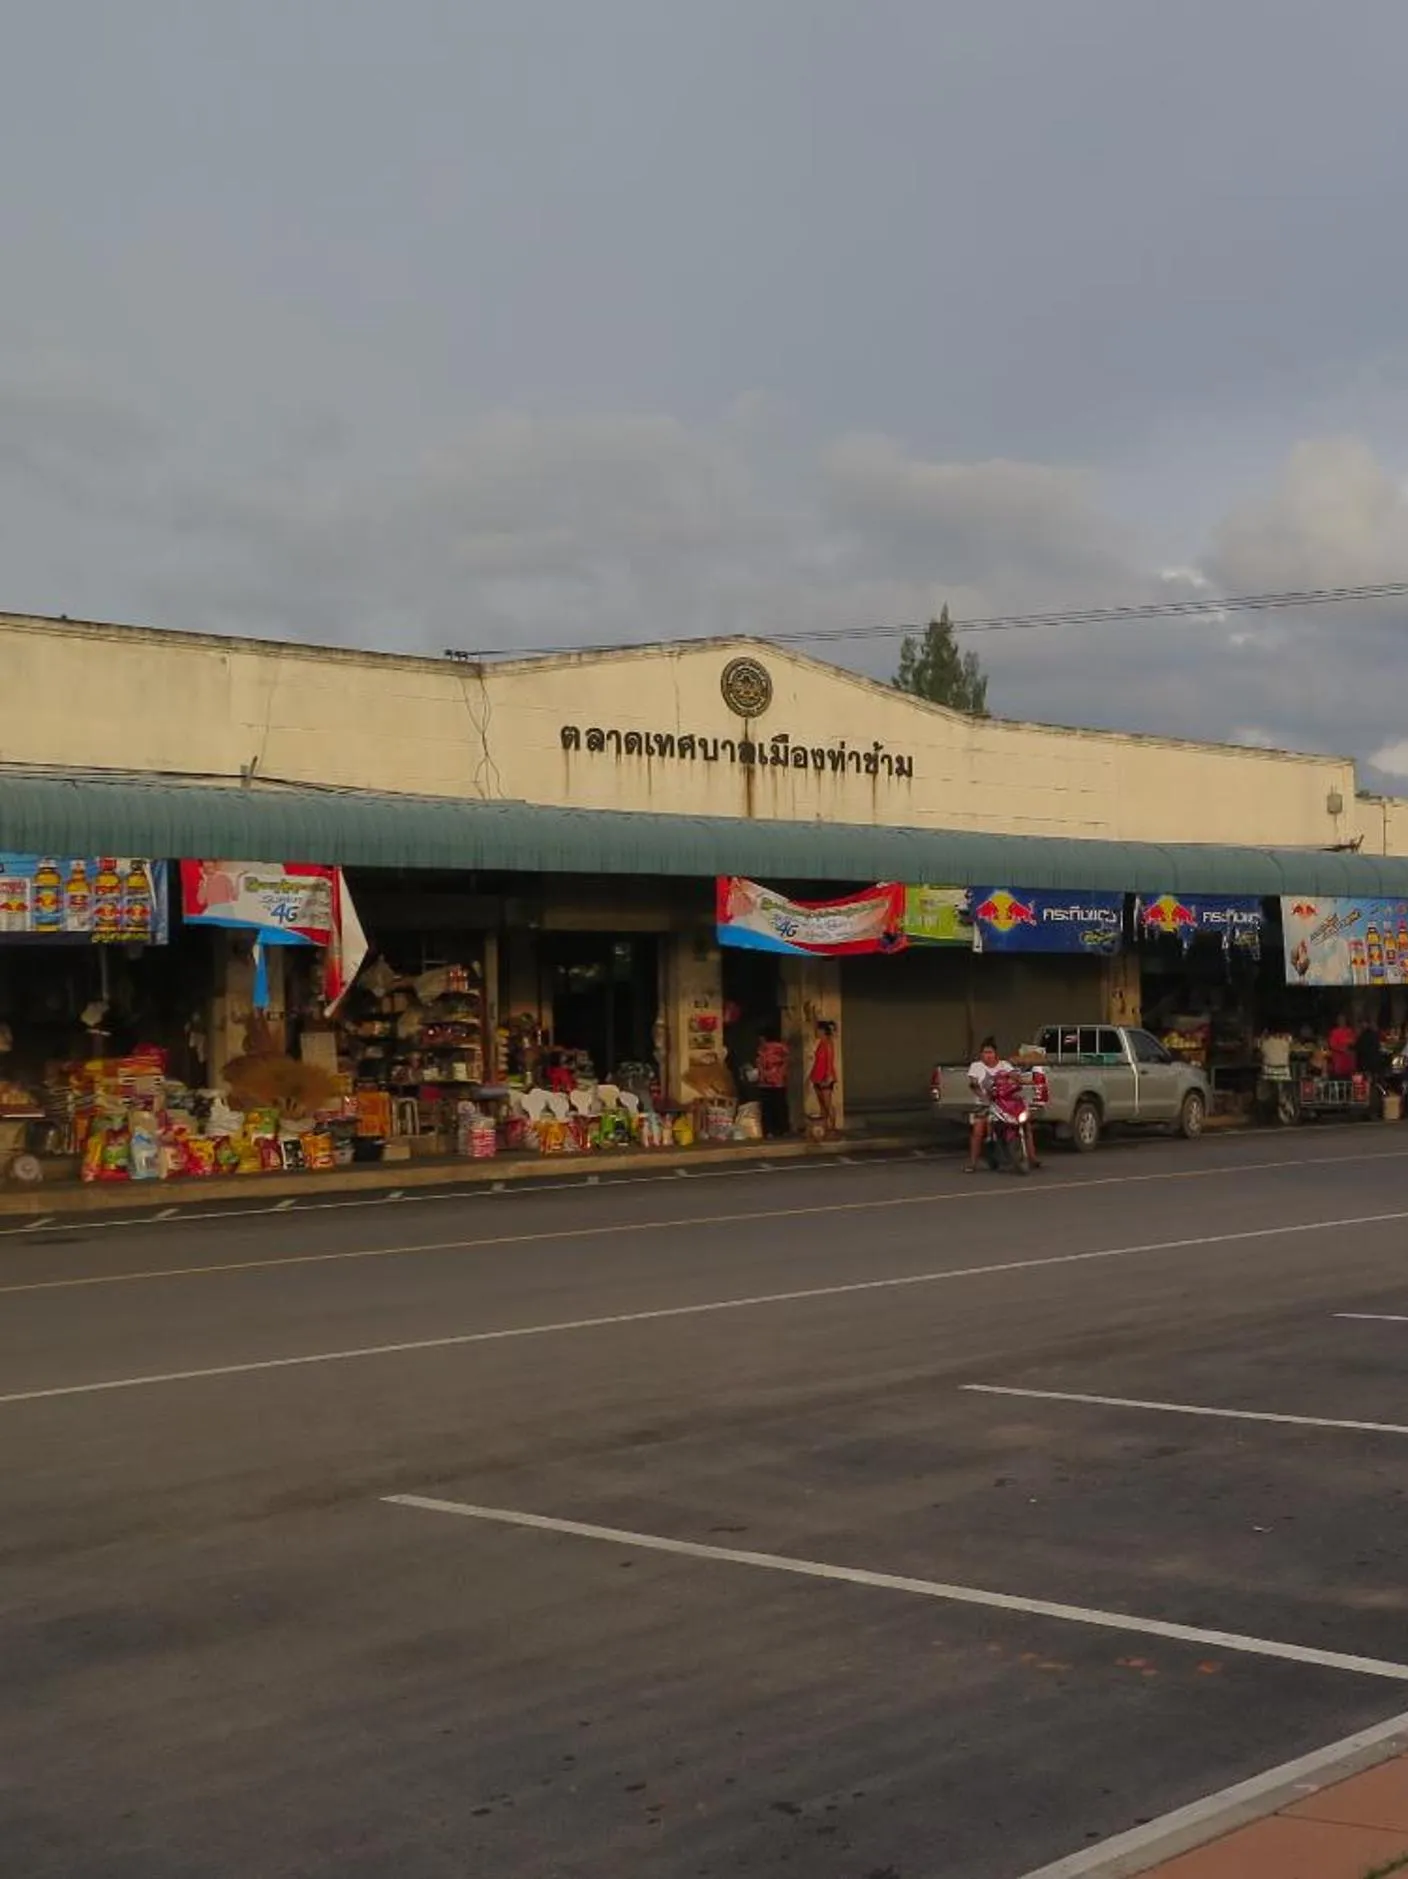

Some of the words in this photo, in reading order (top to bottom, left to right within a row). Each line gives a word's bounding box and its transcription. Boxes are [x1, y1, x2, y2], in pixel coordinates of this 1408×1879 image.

[560, 725, 914, 778] ตลาดเทศบาลเมืองท่าข้าม
[270, 903, 299, 923] 4G
